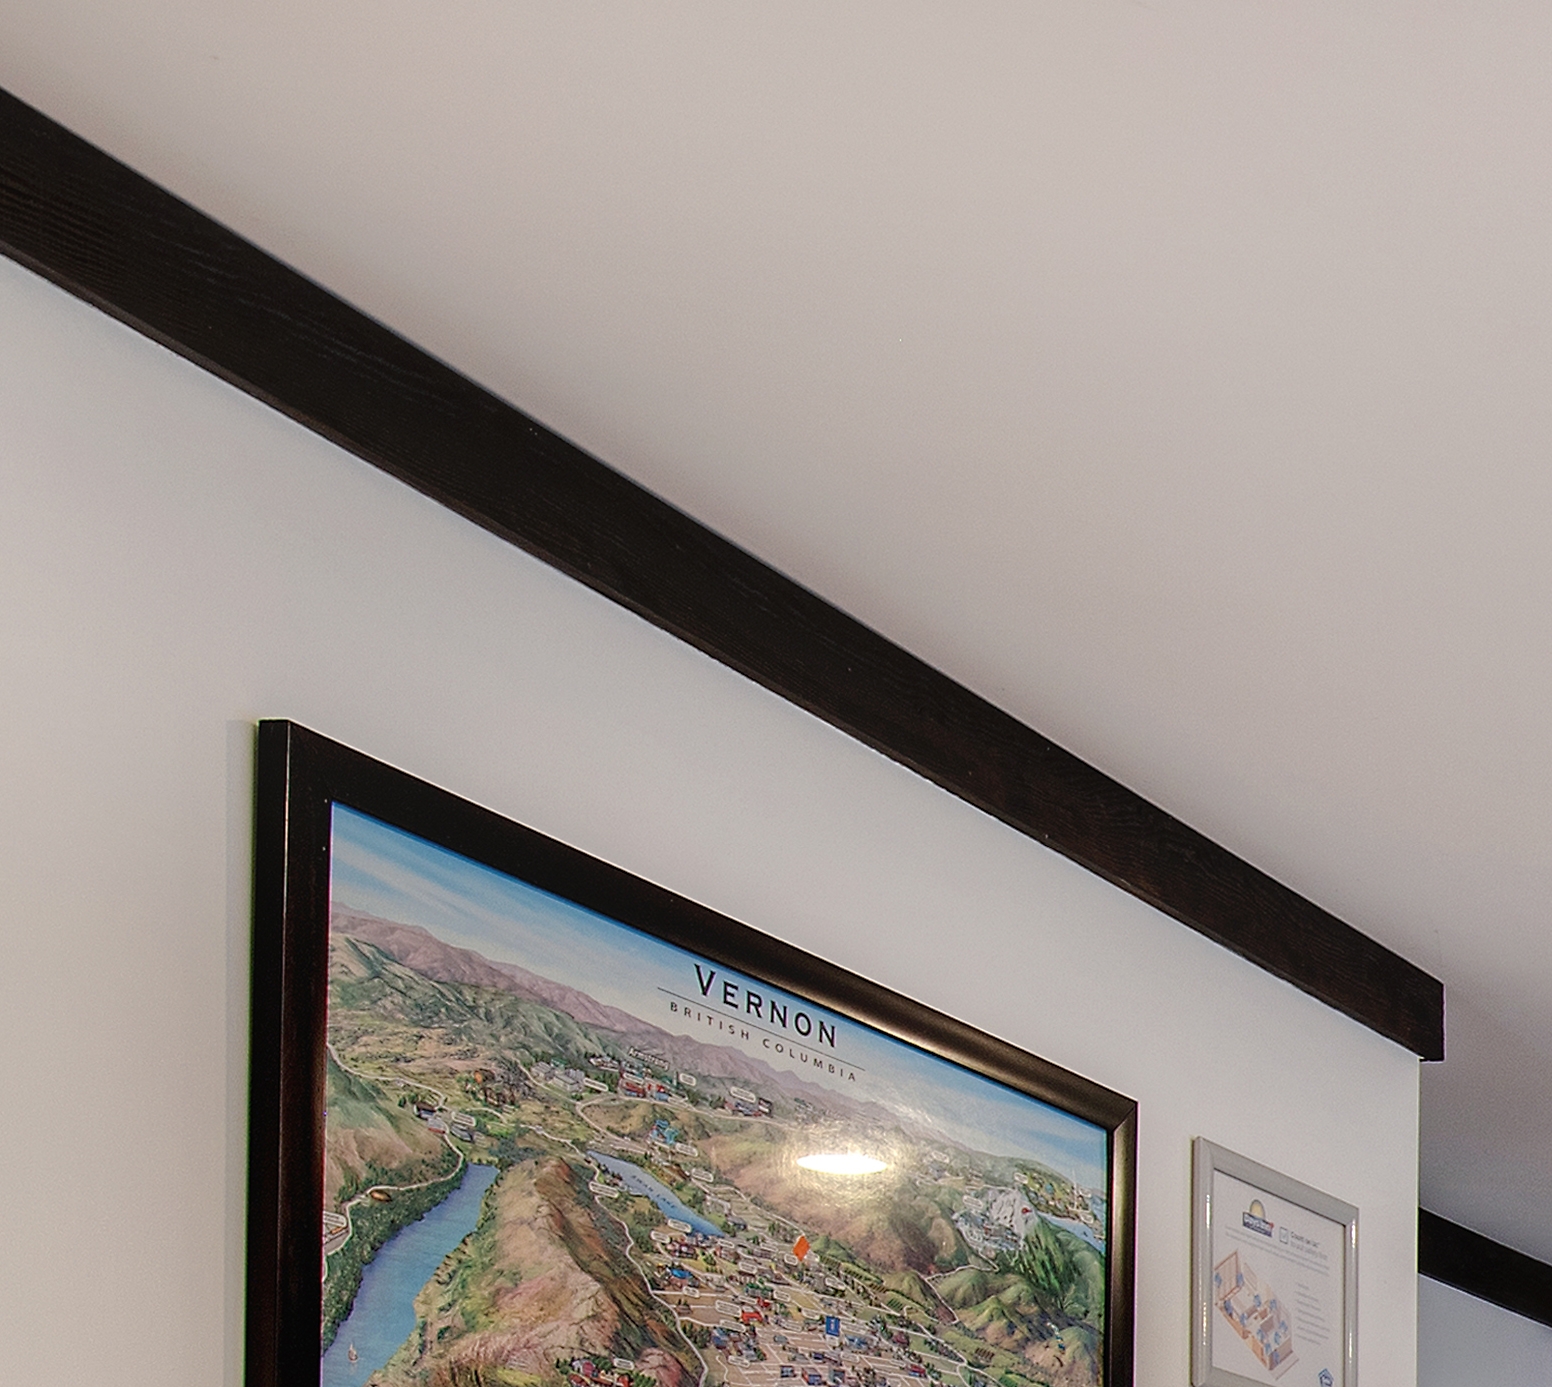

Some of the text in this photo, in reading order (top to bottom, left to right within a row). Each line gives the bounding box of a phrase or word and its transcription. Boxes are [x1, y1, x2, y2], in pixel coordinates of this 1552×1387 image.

[670, 1002, 856, 1082] BRITISH COLUMBIA
[694, 963, 837, 1048] VERNON
